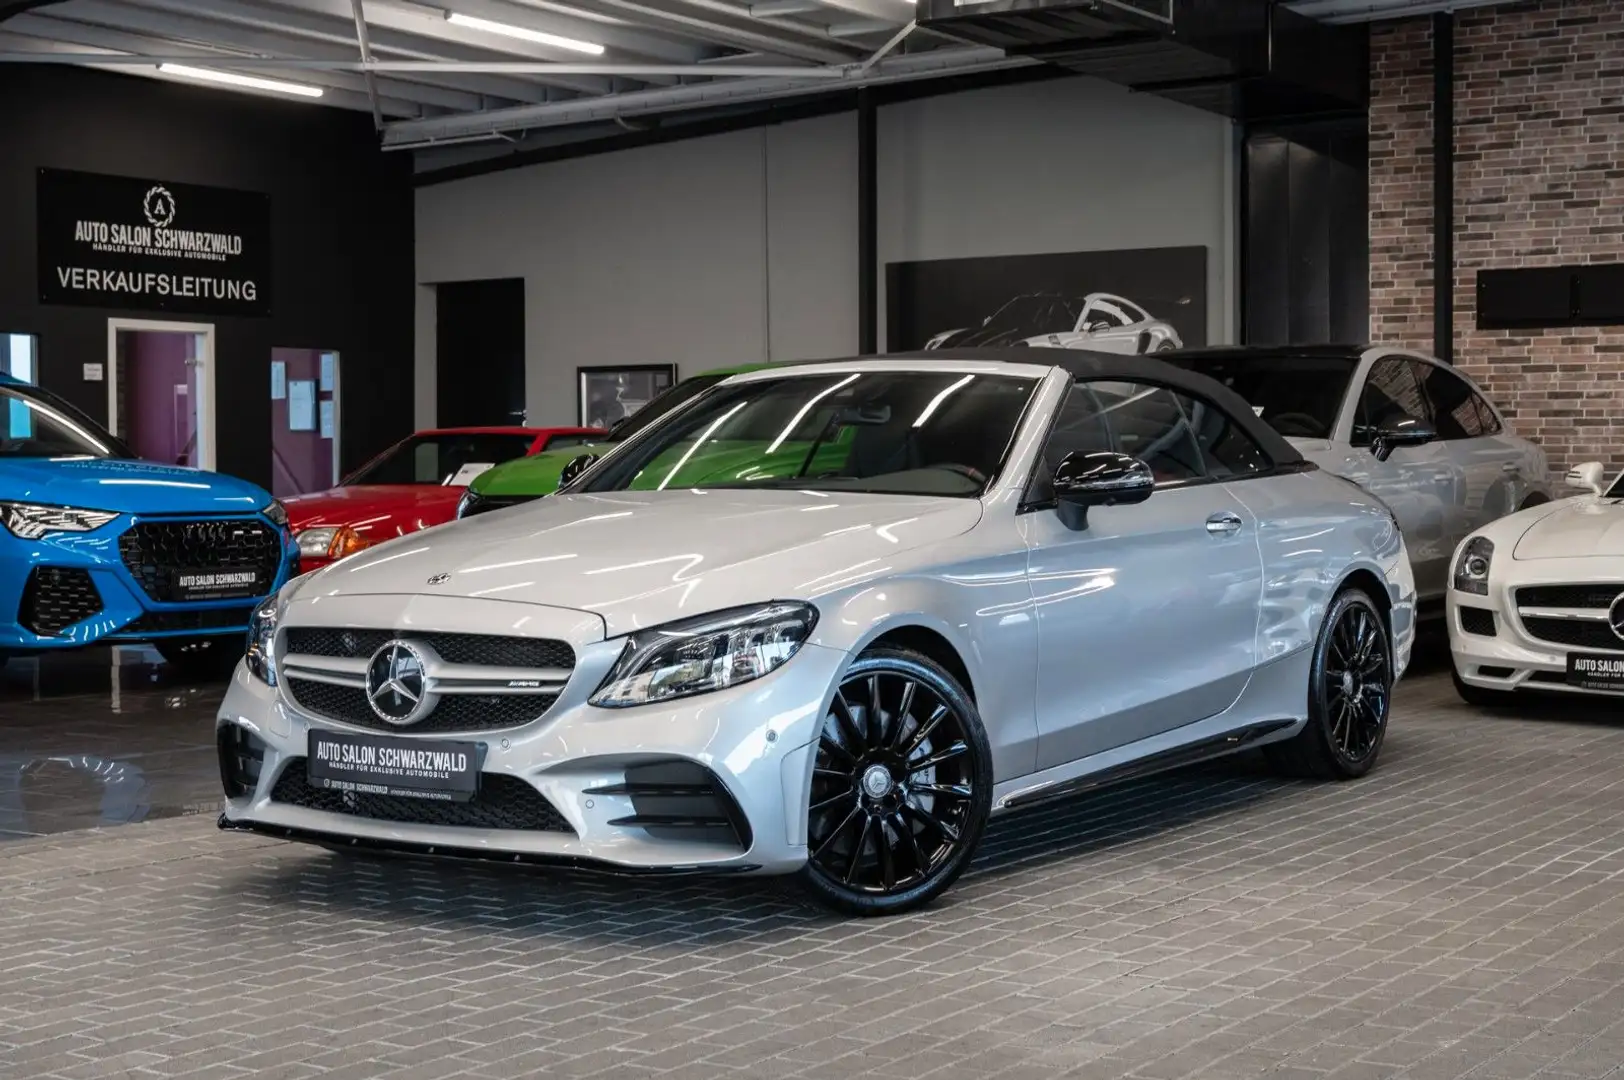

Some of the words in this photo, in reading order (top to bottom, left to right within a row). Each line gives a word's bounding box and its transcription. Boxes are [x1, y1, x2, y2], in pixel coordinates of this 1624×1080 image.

[154, 199, 166, 215] A
[75, 220, 108, 242] AUTO
[111, 224, 150, 246] SALON
[154, 228, 242, 255] SCHWARZWALD
[145, 248, 182, 258] EXKLUSIVE
[184, 250, 226, 261] AUTOMOBILE
[57, 266, 257, 301] VERKAUFSLEITUNG
[179, 575, 195, 587] AUTO
[196, 574, 215, 586] SALON
[216, 571, 256, 584] SCHWARZWALD
[1575, 658, 1596, 671] AUTO
[1597, 659, 1624, 673] SALON
[317, 741, 341, 761] AUTO
[342, 744, 376, 766] SALON
[378, 747, 467, 772] SCHWARZWALD
[356, 763, 368, 773] FÜR
[370, 766, 403, 776] EXKLUSIVE
[406, 769, 449, 779] AUTOMOBILE
